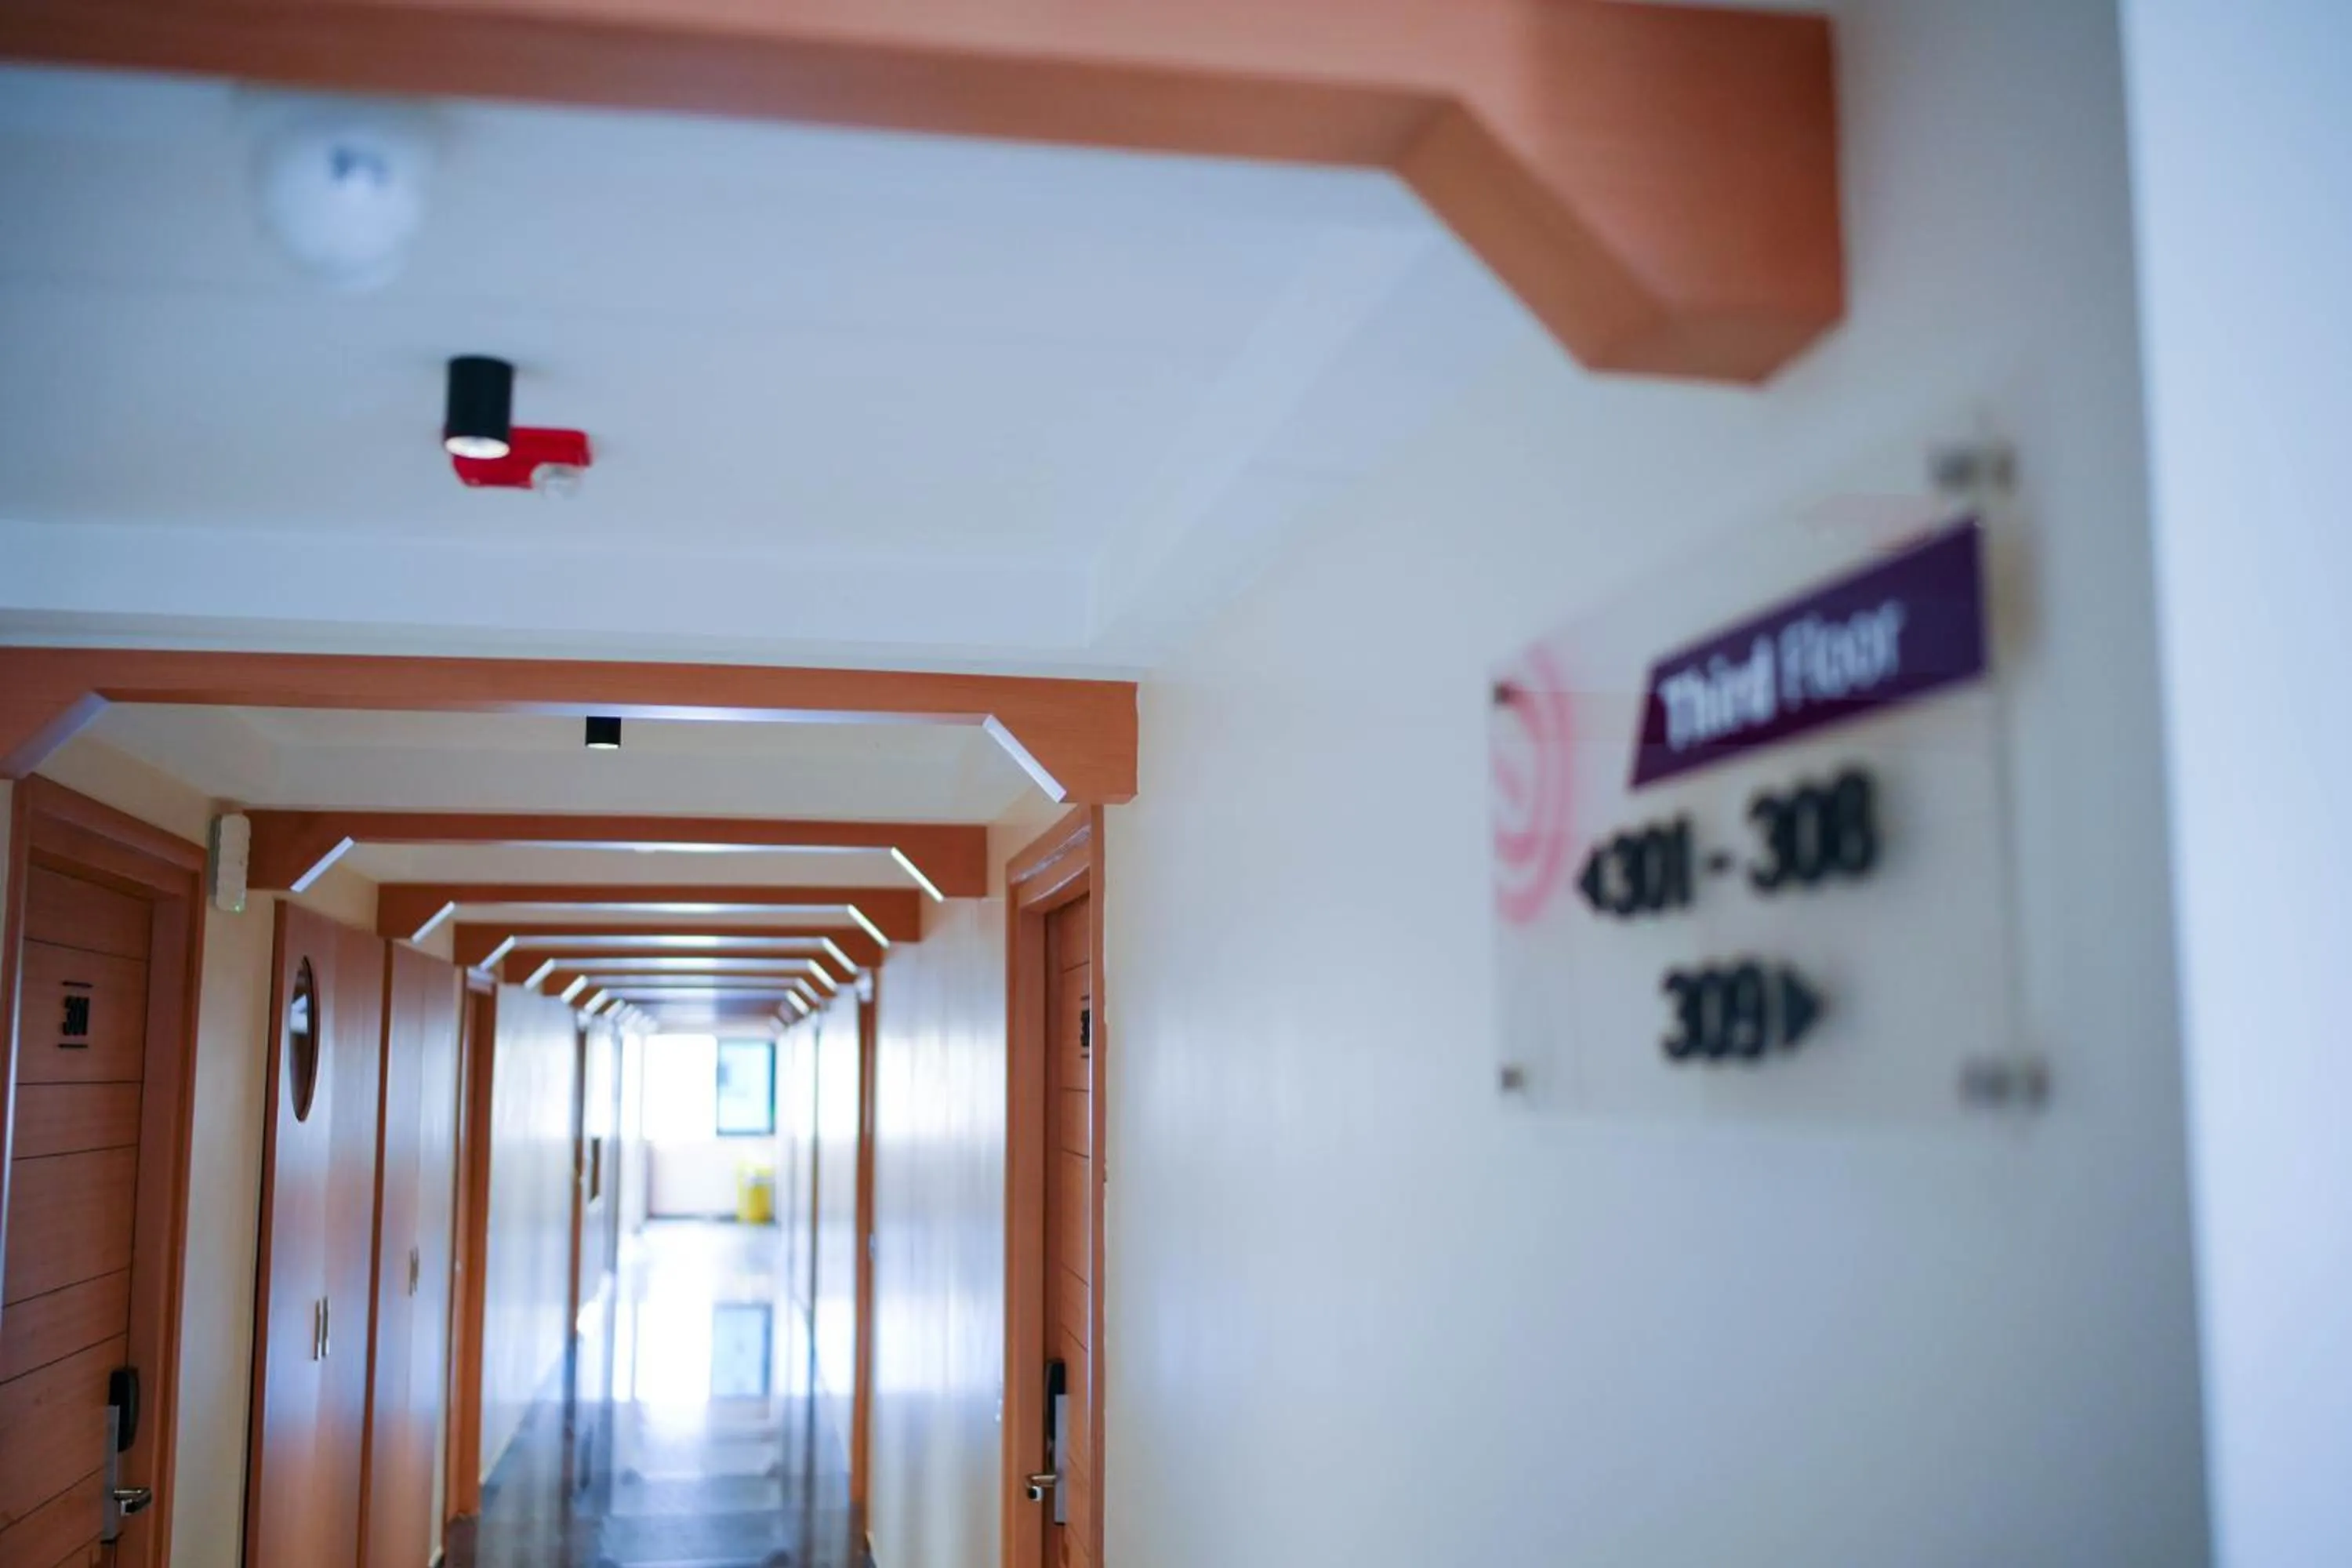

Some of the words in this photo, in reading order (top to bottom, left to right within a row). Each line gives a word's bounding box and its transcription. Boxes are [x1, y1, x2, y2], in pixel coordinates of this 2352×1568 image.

[1659, 646, 1774, 750] Third
[1779, 601, 1904, 707] Floor
[1749, 767, 1878, 895] 308
[1661, 960, 1769, 1065] 309
